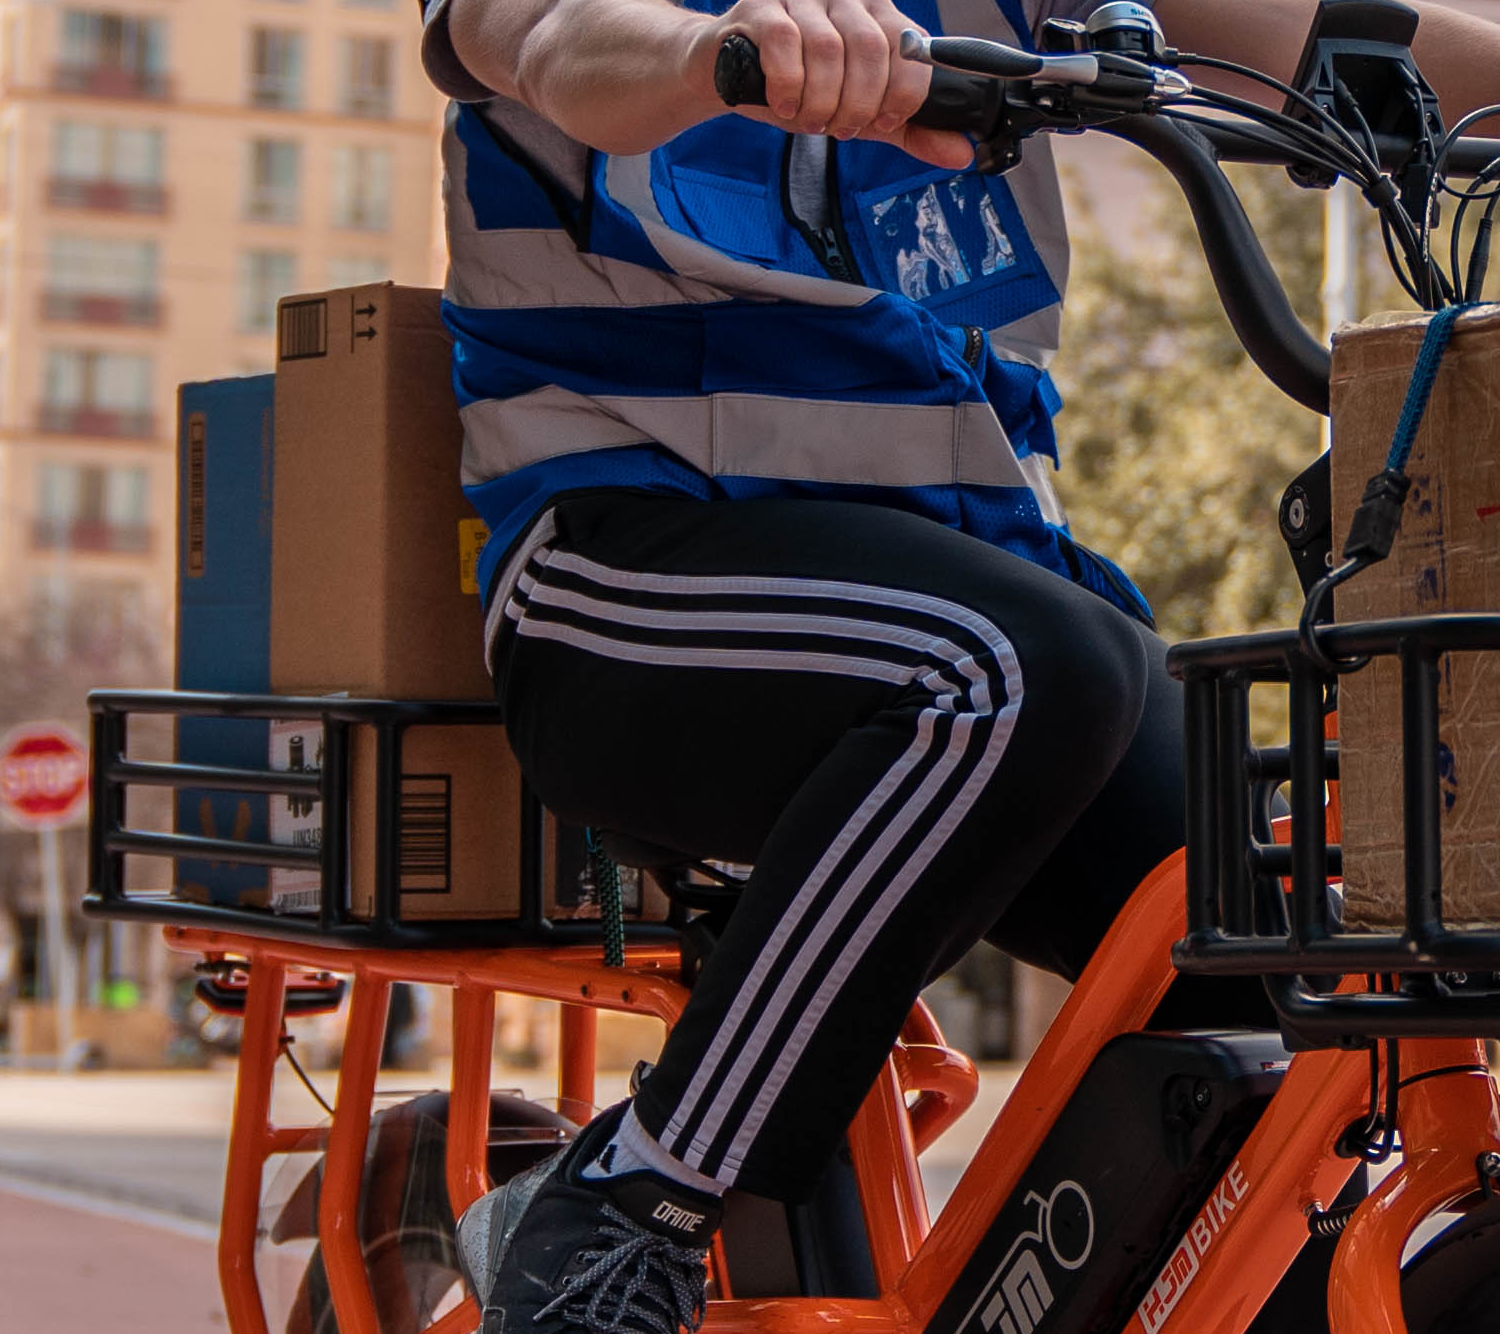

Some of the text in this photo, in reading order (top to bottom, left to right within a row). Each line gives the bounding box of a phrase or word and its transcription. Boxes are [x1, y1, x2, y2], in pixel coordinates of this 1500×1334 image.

[3, 756, 83, 794] STOP
[652, 1200, 706, 1232] DAME
[1190, 1160, 1250, 1257] BIKE
